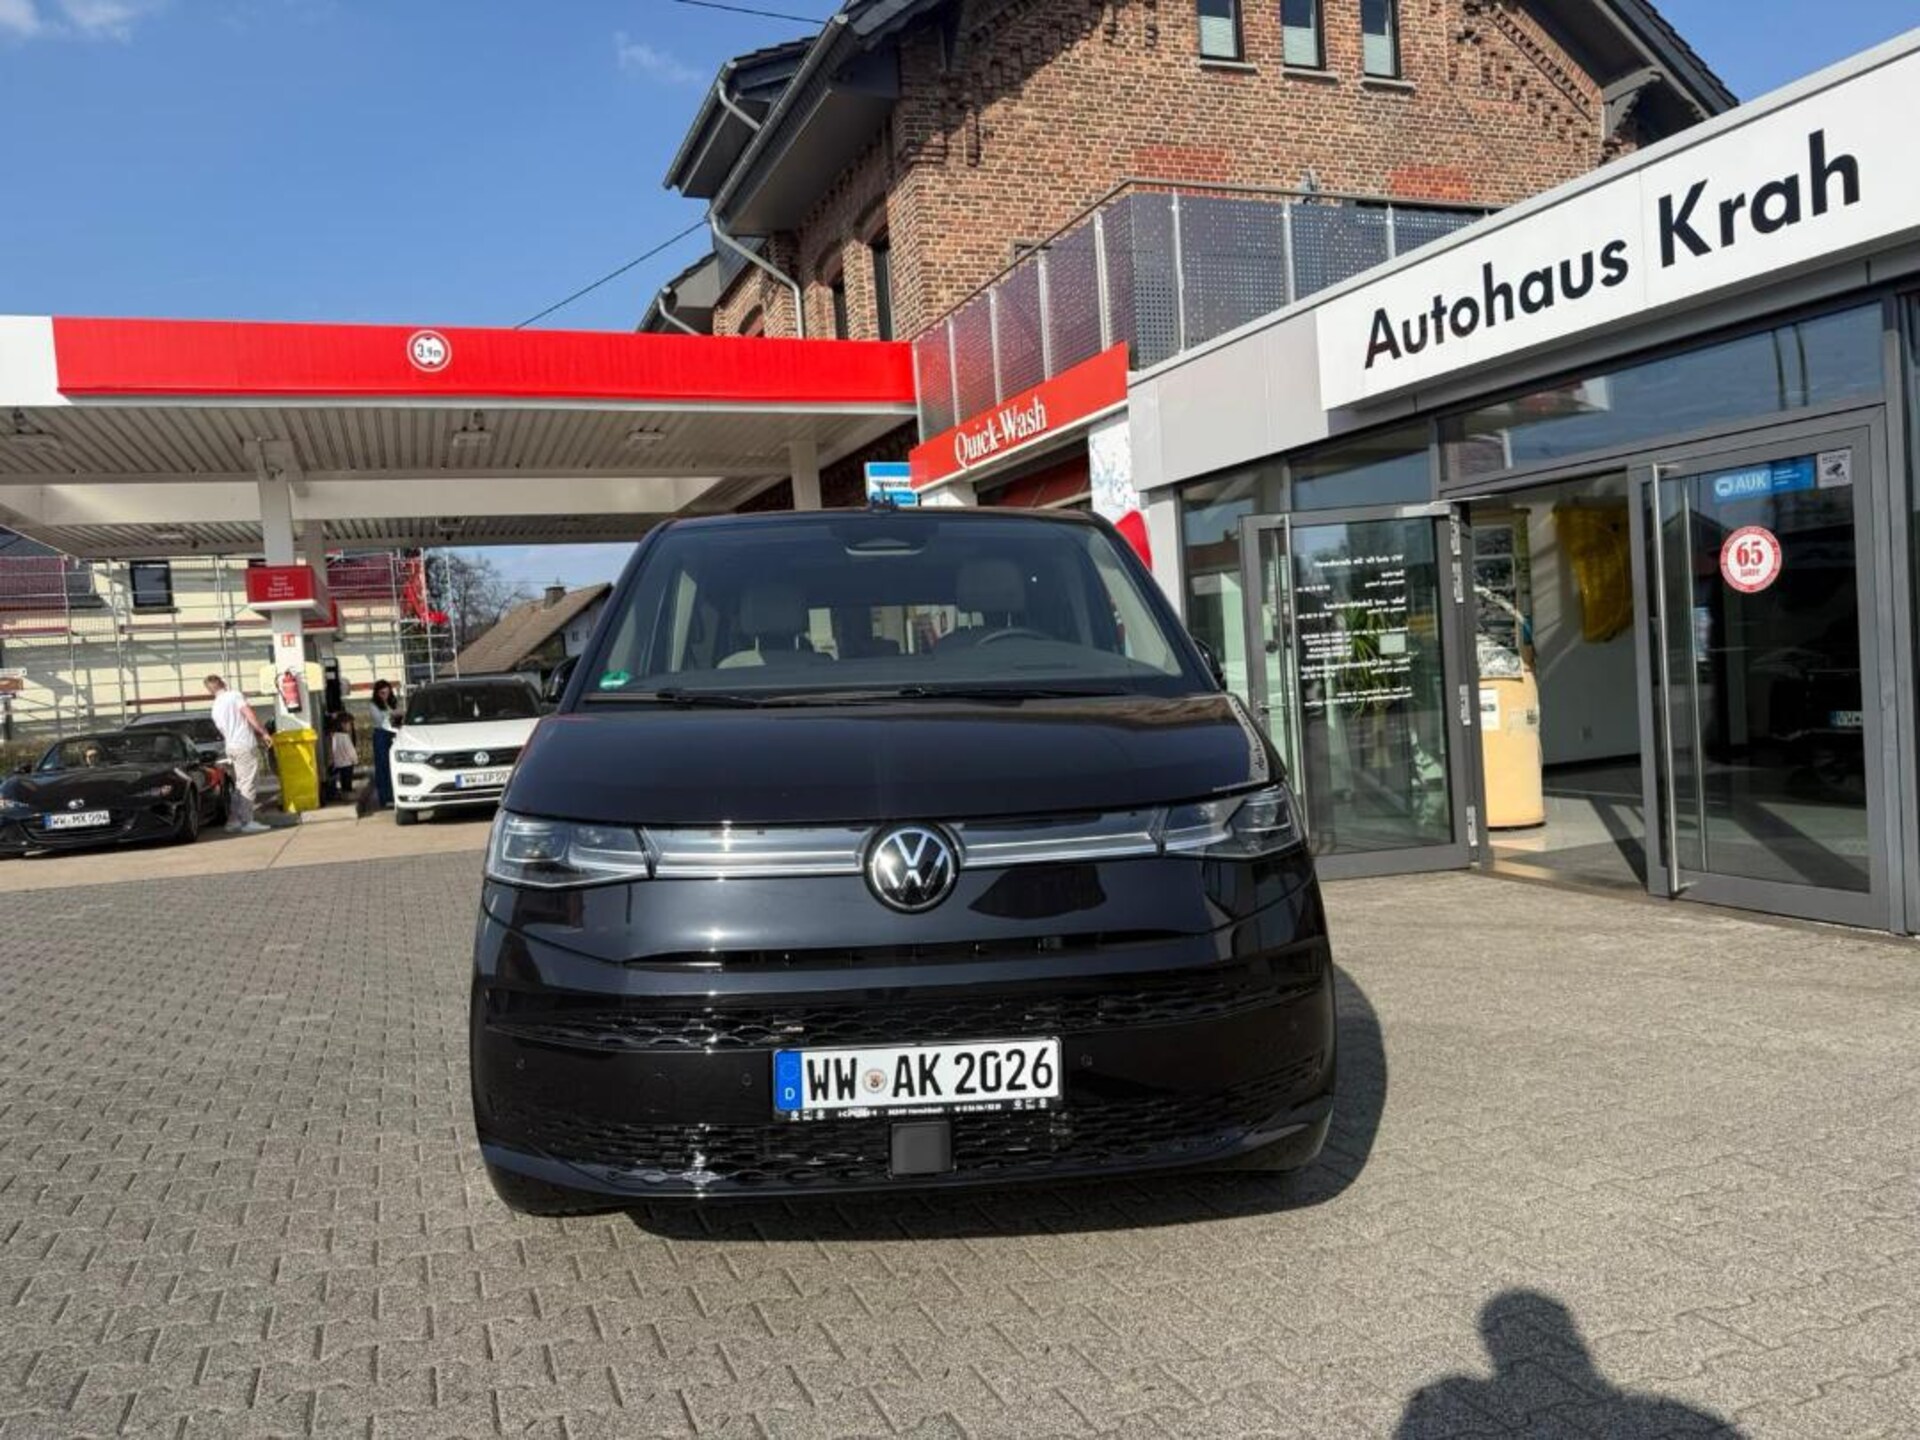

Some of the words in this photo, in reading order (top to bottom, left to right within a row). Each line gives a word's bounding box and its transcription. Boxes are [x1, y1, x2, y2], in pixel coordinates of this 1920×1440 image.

[1364, 239, 1629, 370] Autohaus
[1658, 129, 1861, 268] Krah
[954, 396, 1047, 469] Quick-Wash
[1736, 541, 1763, 567] 65
[784, 1087, 796, 1101] D
[806, 1056, 858, 1102] WW
[892, 1052, 943, 1098] AK
[953, 1046, 1054, 1095] 2026
